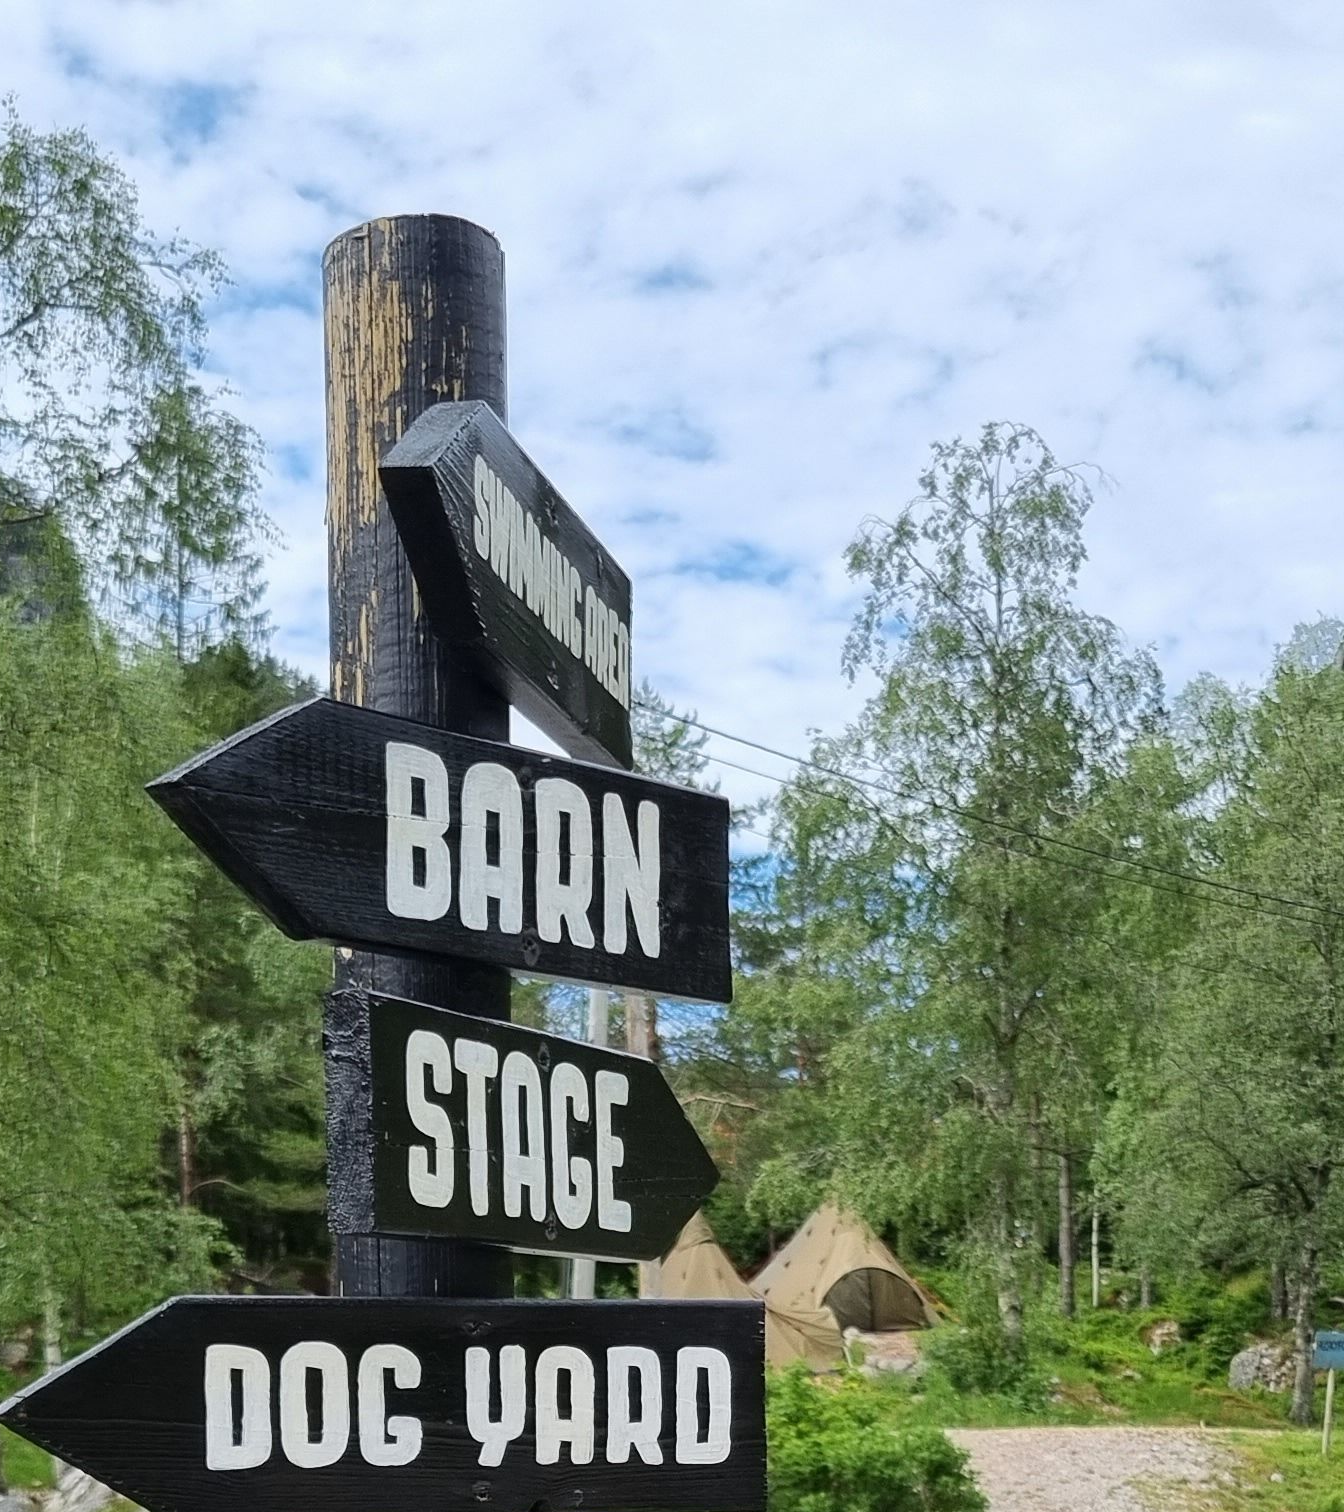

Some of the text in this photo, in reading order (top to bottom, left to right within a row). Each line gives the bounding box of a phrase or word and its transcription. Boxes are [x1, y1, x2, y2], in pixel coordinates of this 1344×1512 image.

[473, 454, 630, 711] SWIMMING AREA
[384, 740, 661, 959] BARN
[405, 1029, 632, 1233] STAGE
[204, 1340, 732, 1471] DOG YARD
